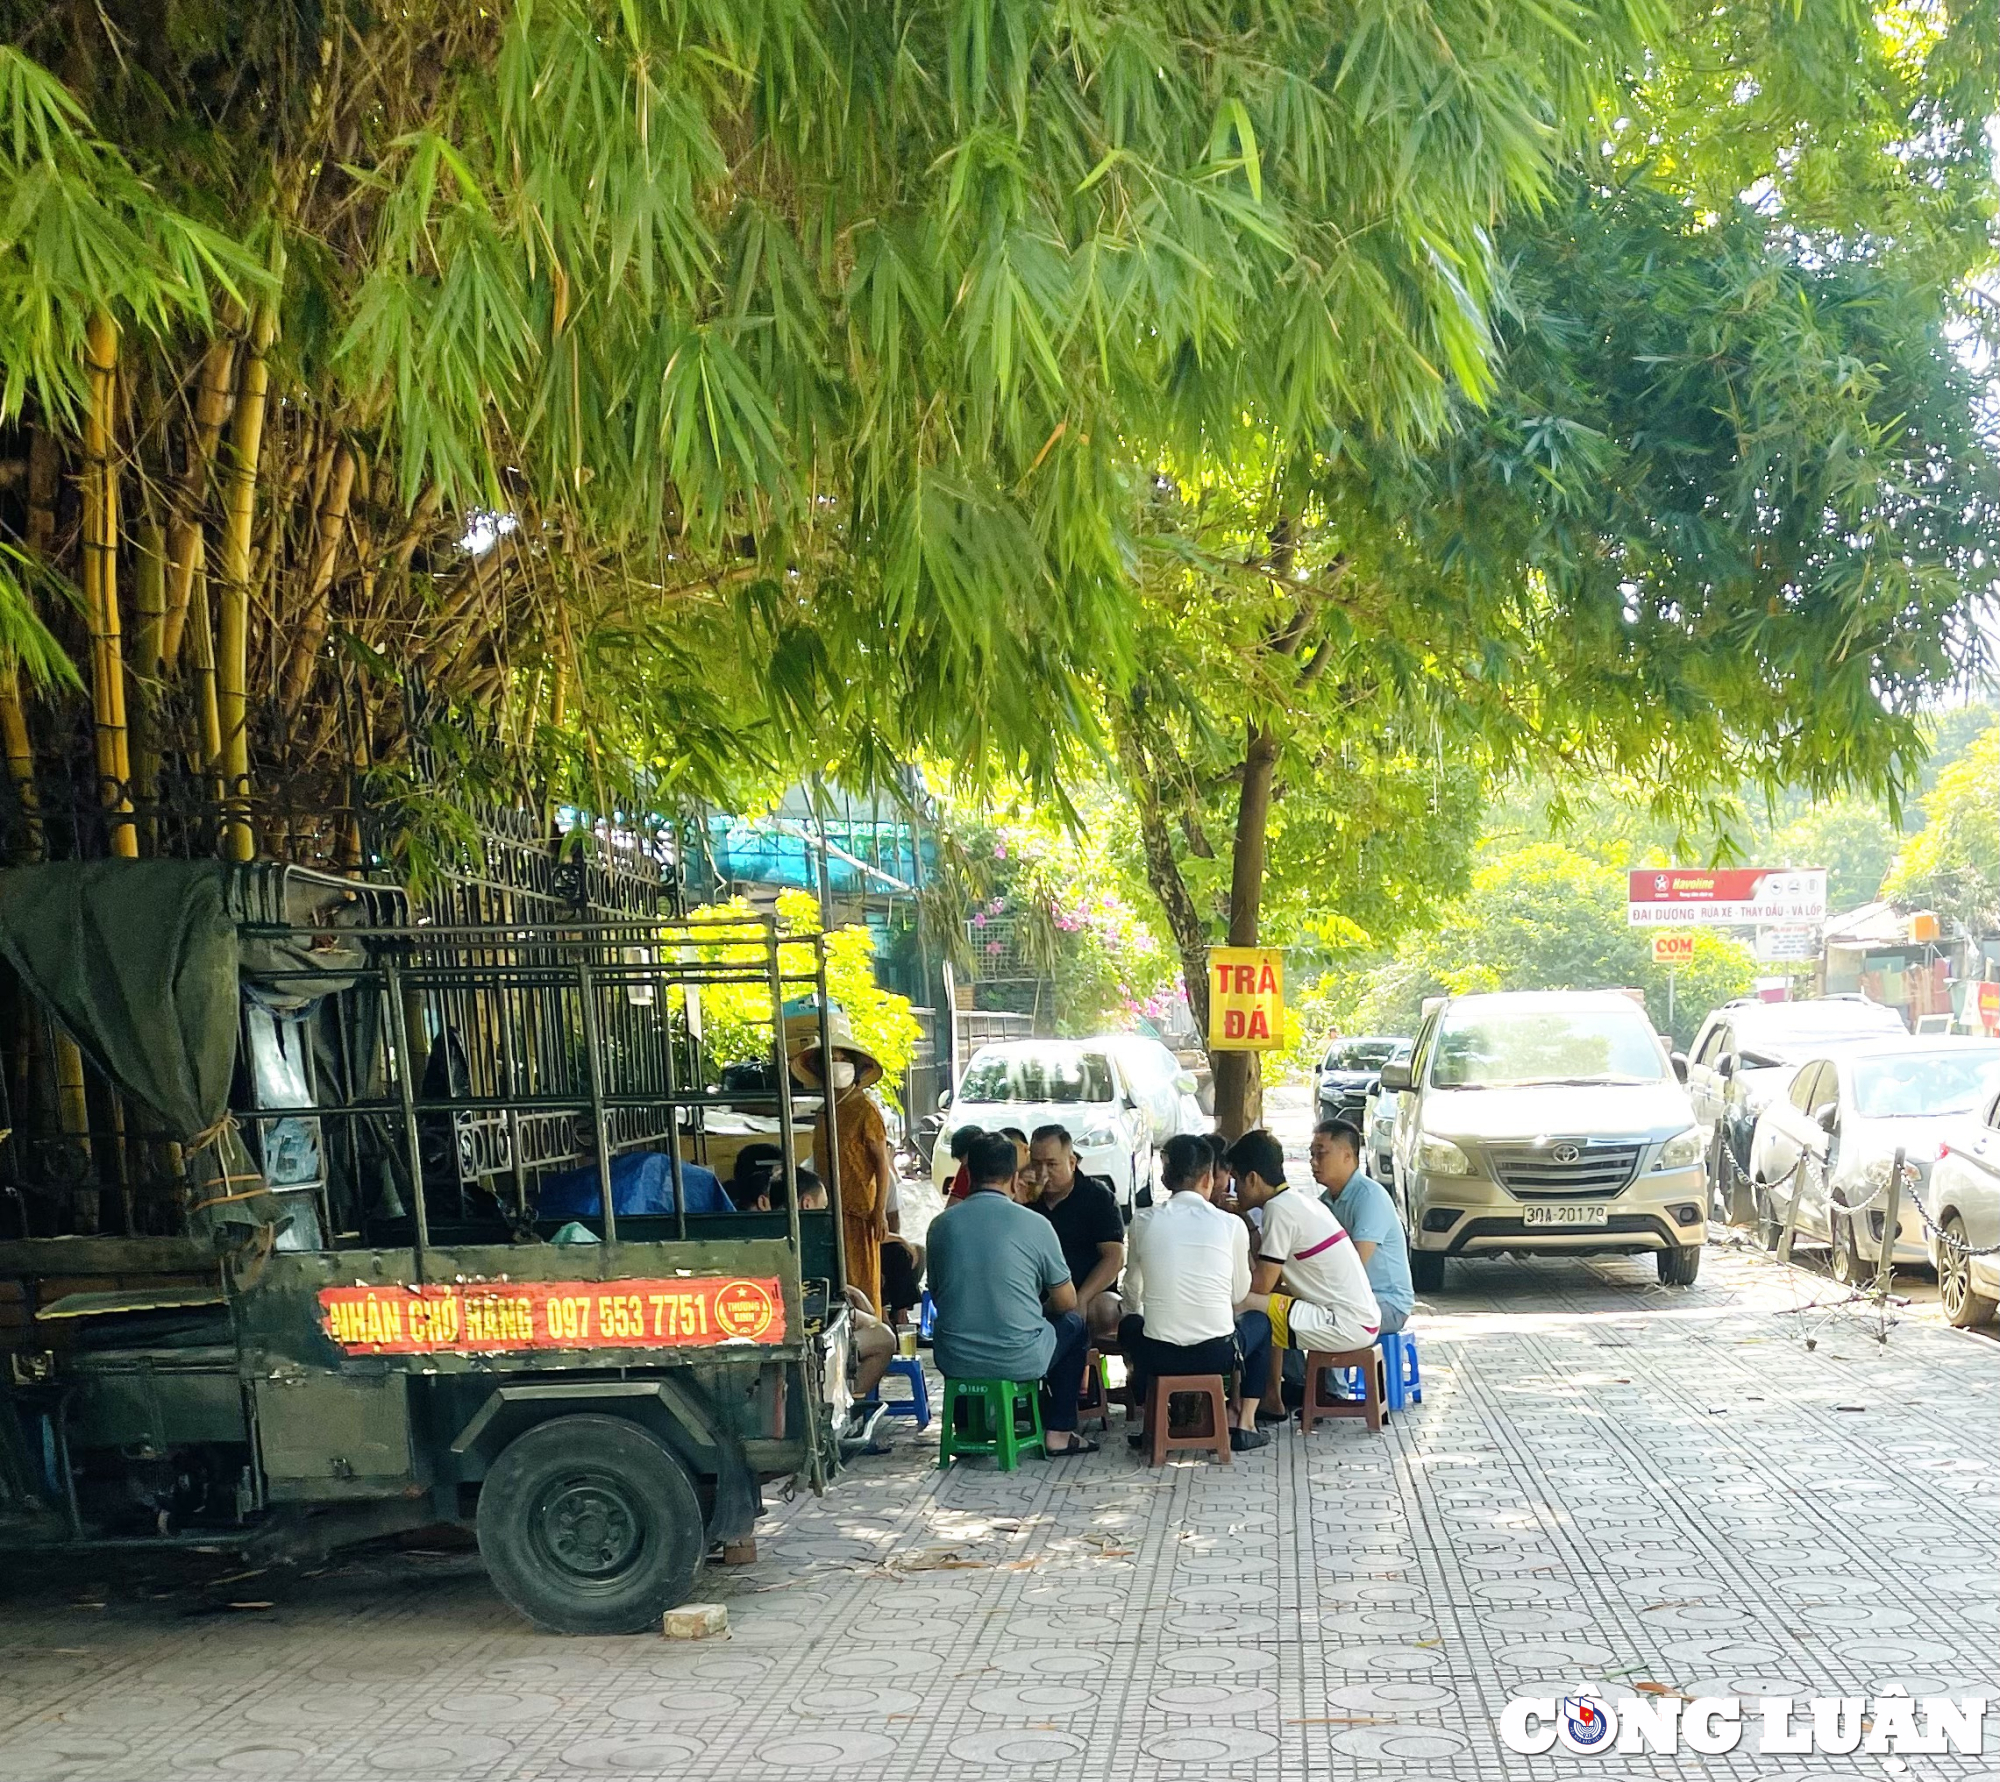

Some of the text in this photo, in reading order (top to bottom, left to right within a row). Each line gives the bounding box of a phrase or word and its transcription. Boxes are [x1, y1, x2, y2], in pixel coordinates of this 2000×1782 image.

[1672, 878, 1715, 890] Havoline
[1655, 907, 1695, 920] DƯƠNG
[1722, 906, 1733, 917] XE
[1740, 906, 1763, 917] THAY
[1655, 937, 1693, 953] CƠM
[1215, 958, 1278, 994] TRÀ
[1223, 1004, 1270, 1039] ĐÁ
[329, 1292, 402, 1353] NHẬN
[407, 1284, 459, 1342] CHỞ
[546, 1297, 591, 1339] 097
[598, 1295, 645, 1337] 553
[649, 1294, 708, 1336] 7751
